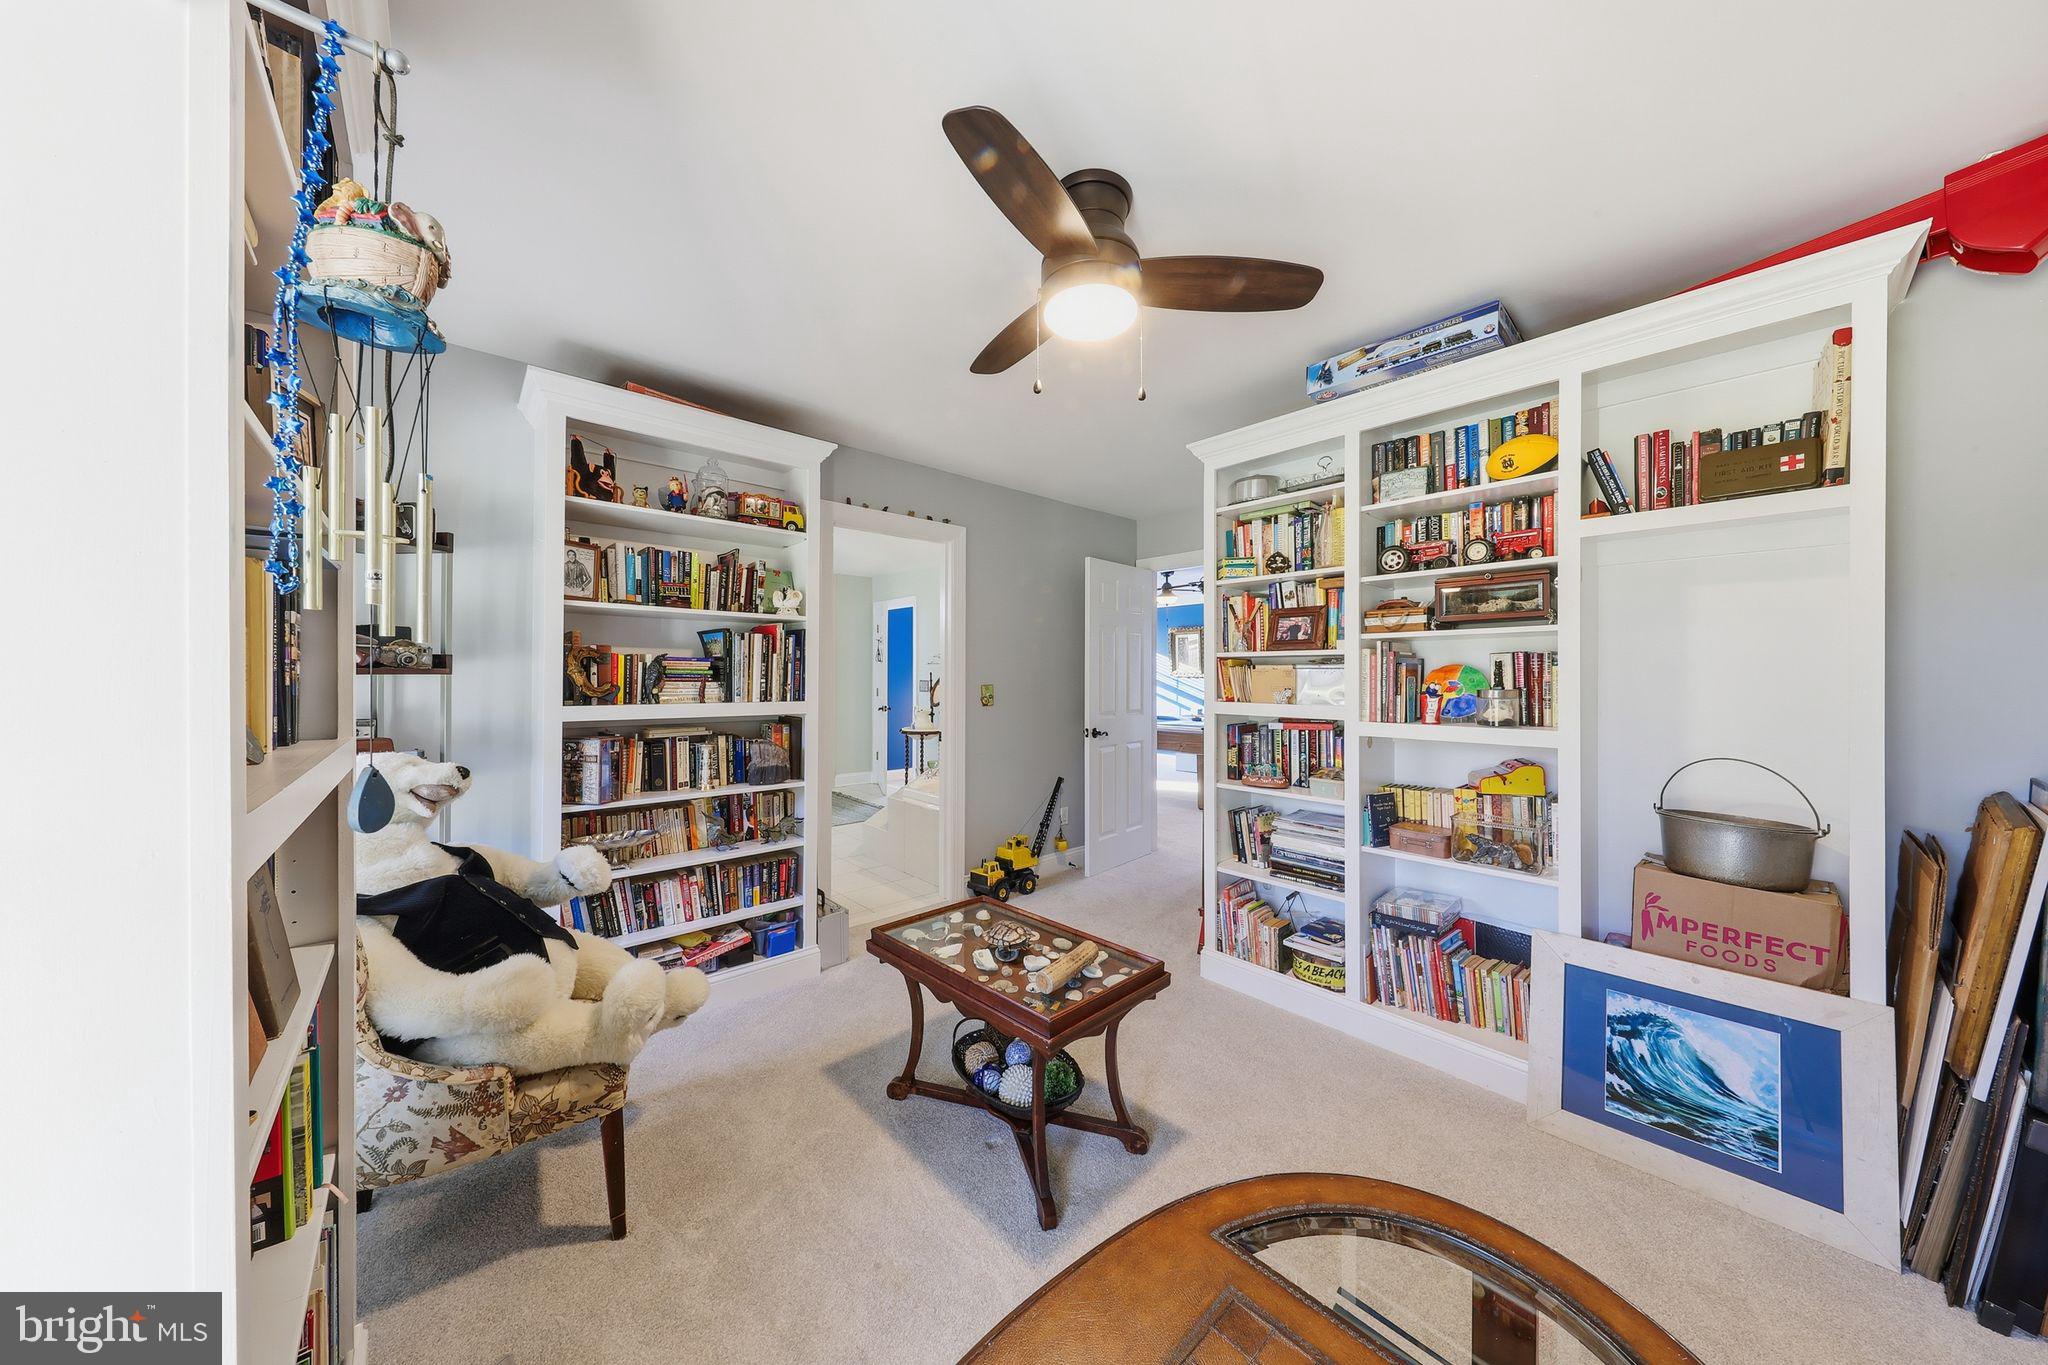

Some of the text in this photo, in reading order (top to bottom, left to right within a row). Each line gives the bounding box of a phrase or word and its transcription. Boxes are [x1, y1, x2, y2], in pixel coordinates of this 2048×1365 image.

[1836, 350, 1846, 377] PICTURE
[1457, 428, 1468, 480] JAMES PATTERSON
[1715, 469, 1737, 477] FIRST
[1759, 463, 1773, 471] KIT
[1686, 940, 1777, 973] FOODS
[1312, 966, 1345, 978] BEACH
